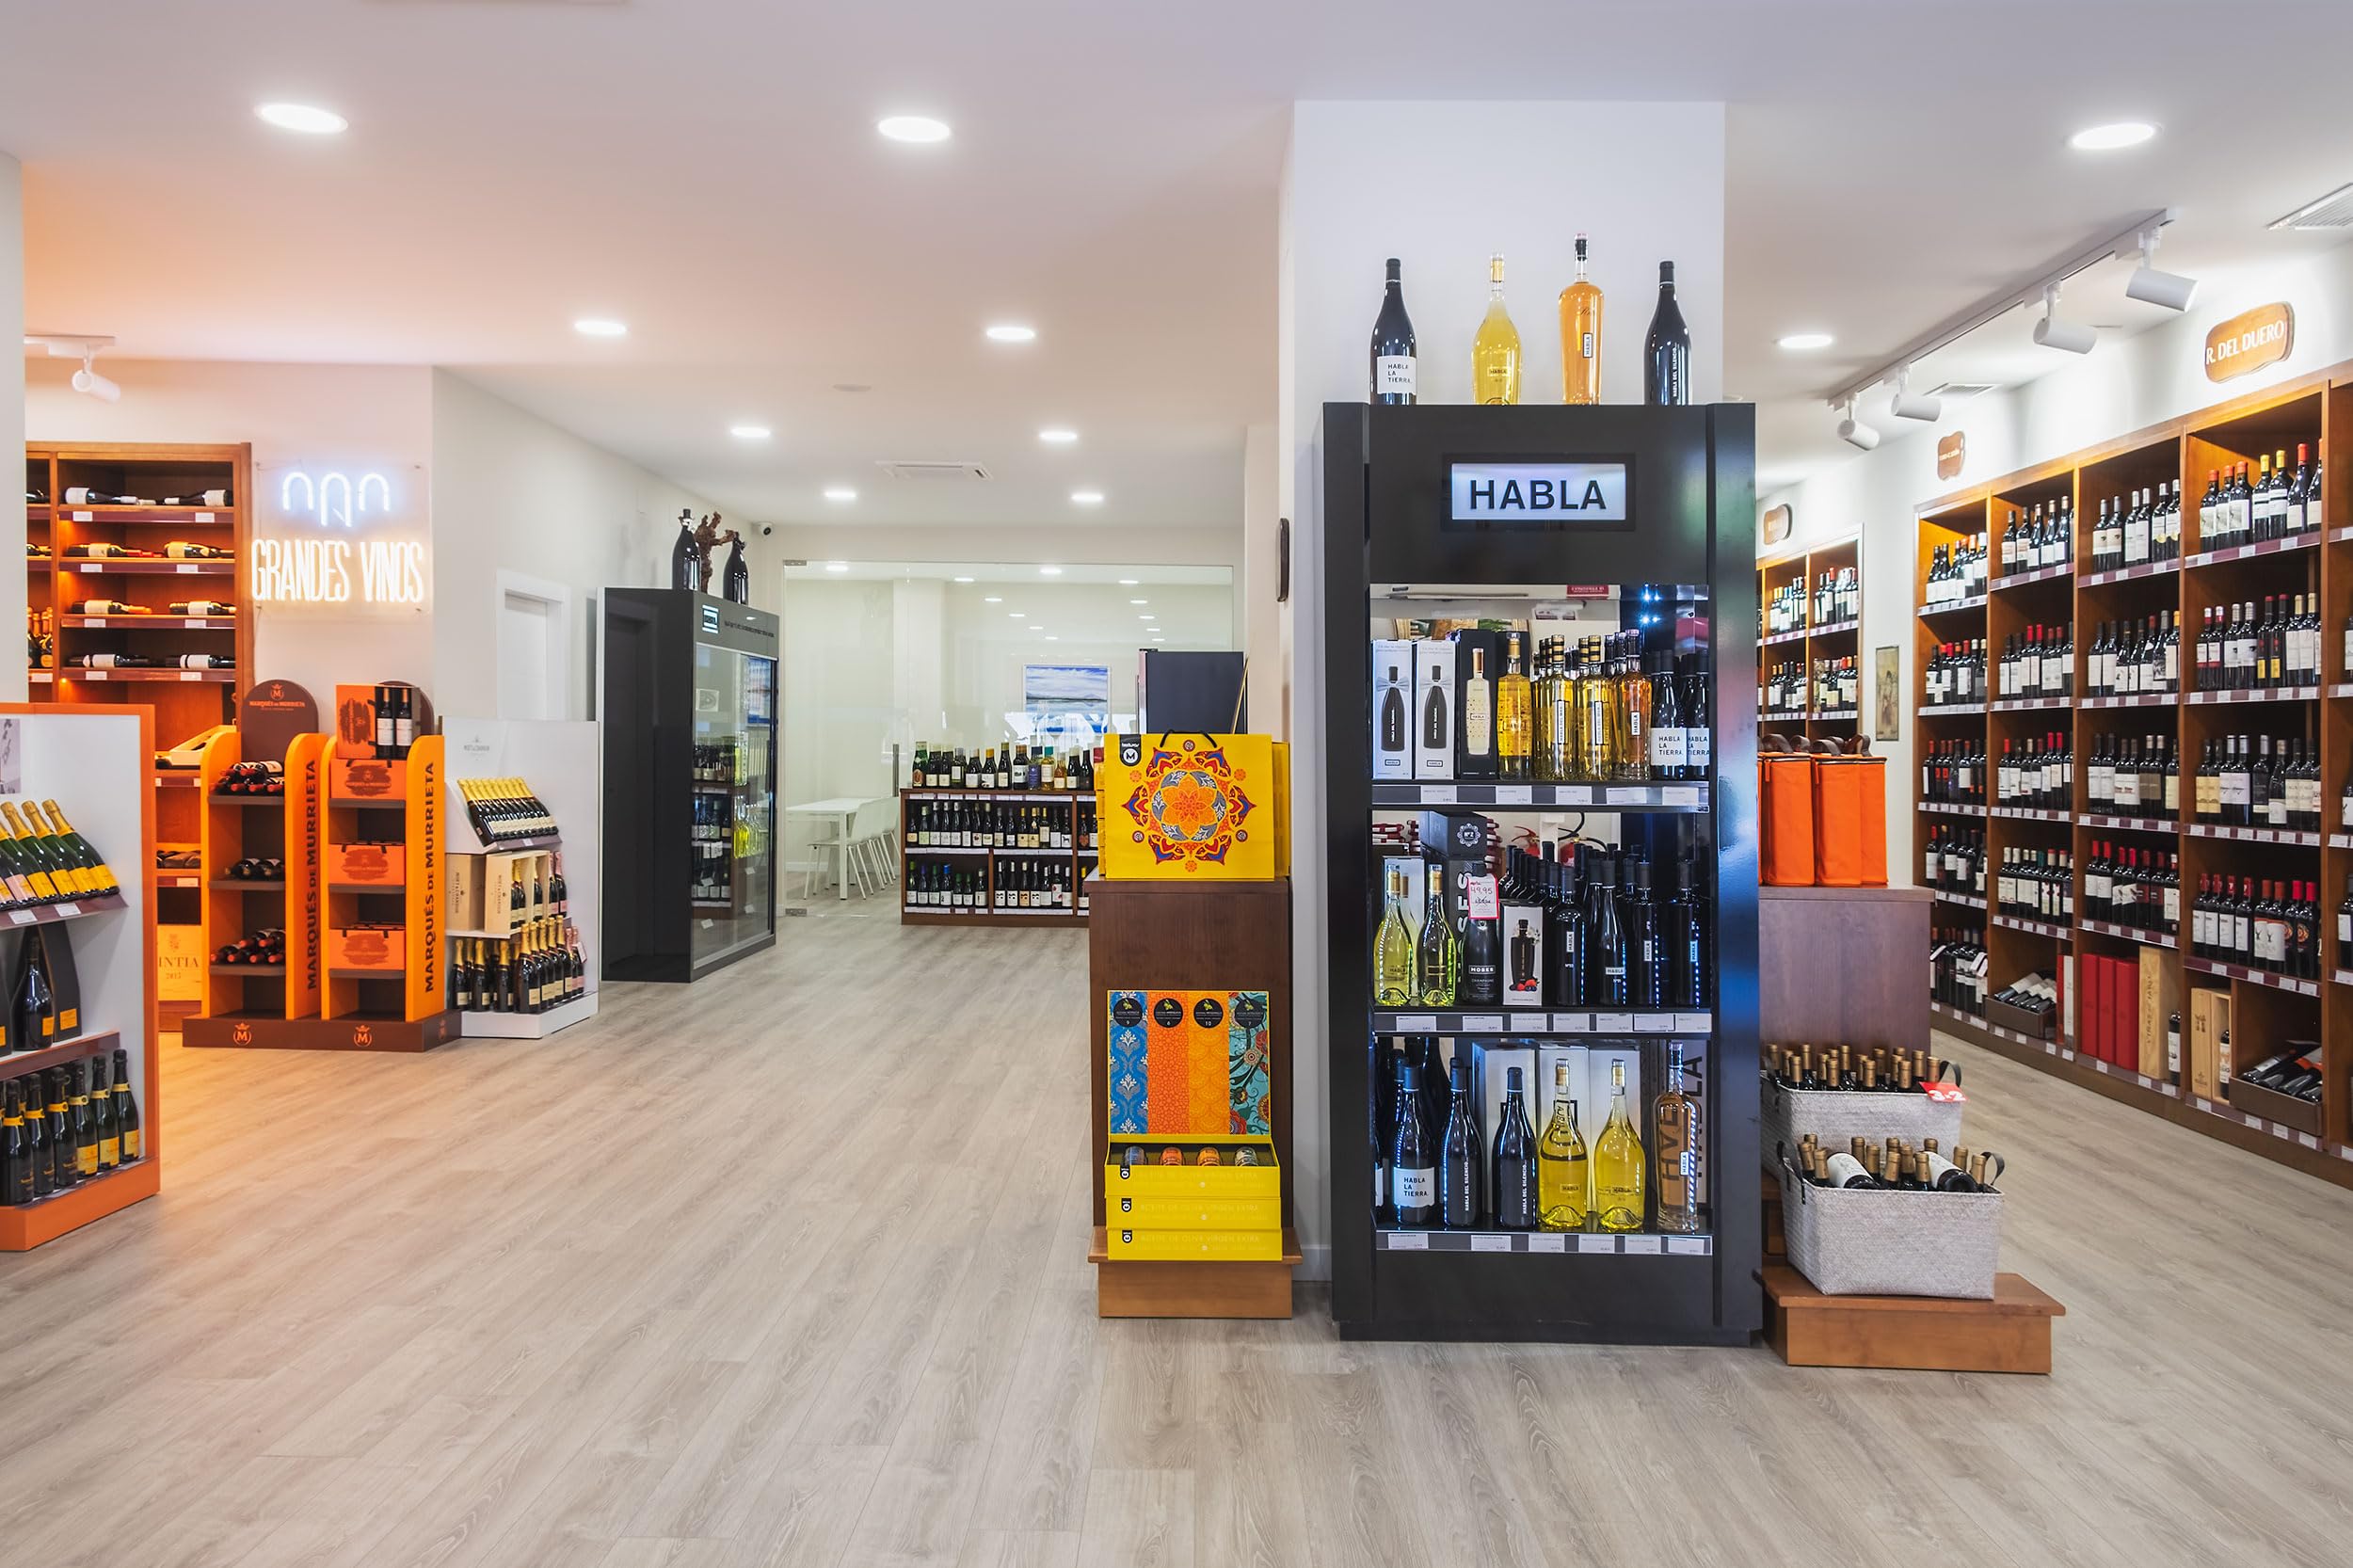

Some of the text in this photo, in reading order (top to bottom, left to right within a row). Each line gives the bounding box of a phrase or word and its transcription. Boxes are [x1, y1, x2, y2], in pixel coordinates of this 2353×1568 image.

[2205, 320, 2285, 365] R. DEL DUERO
[1470, 479, 1607, 510] HABLA
[250, 538, 424, 603] GRANDES VINOS
[305, 760, 318, 990] MARQUÉS DE MURRIETA
[424, 762, 437, 993] MARQUÉS DE MURRIETA
[1470, 887, 1493, 895] 49,95
[159, 956, 199, 968] INTIA
